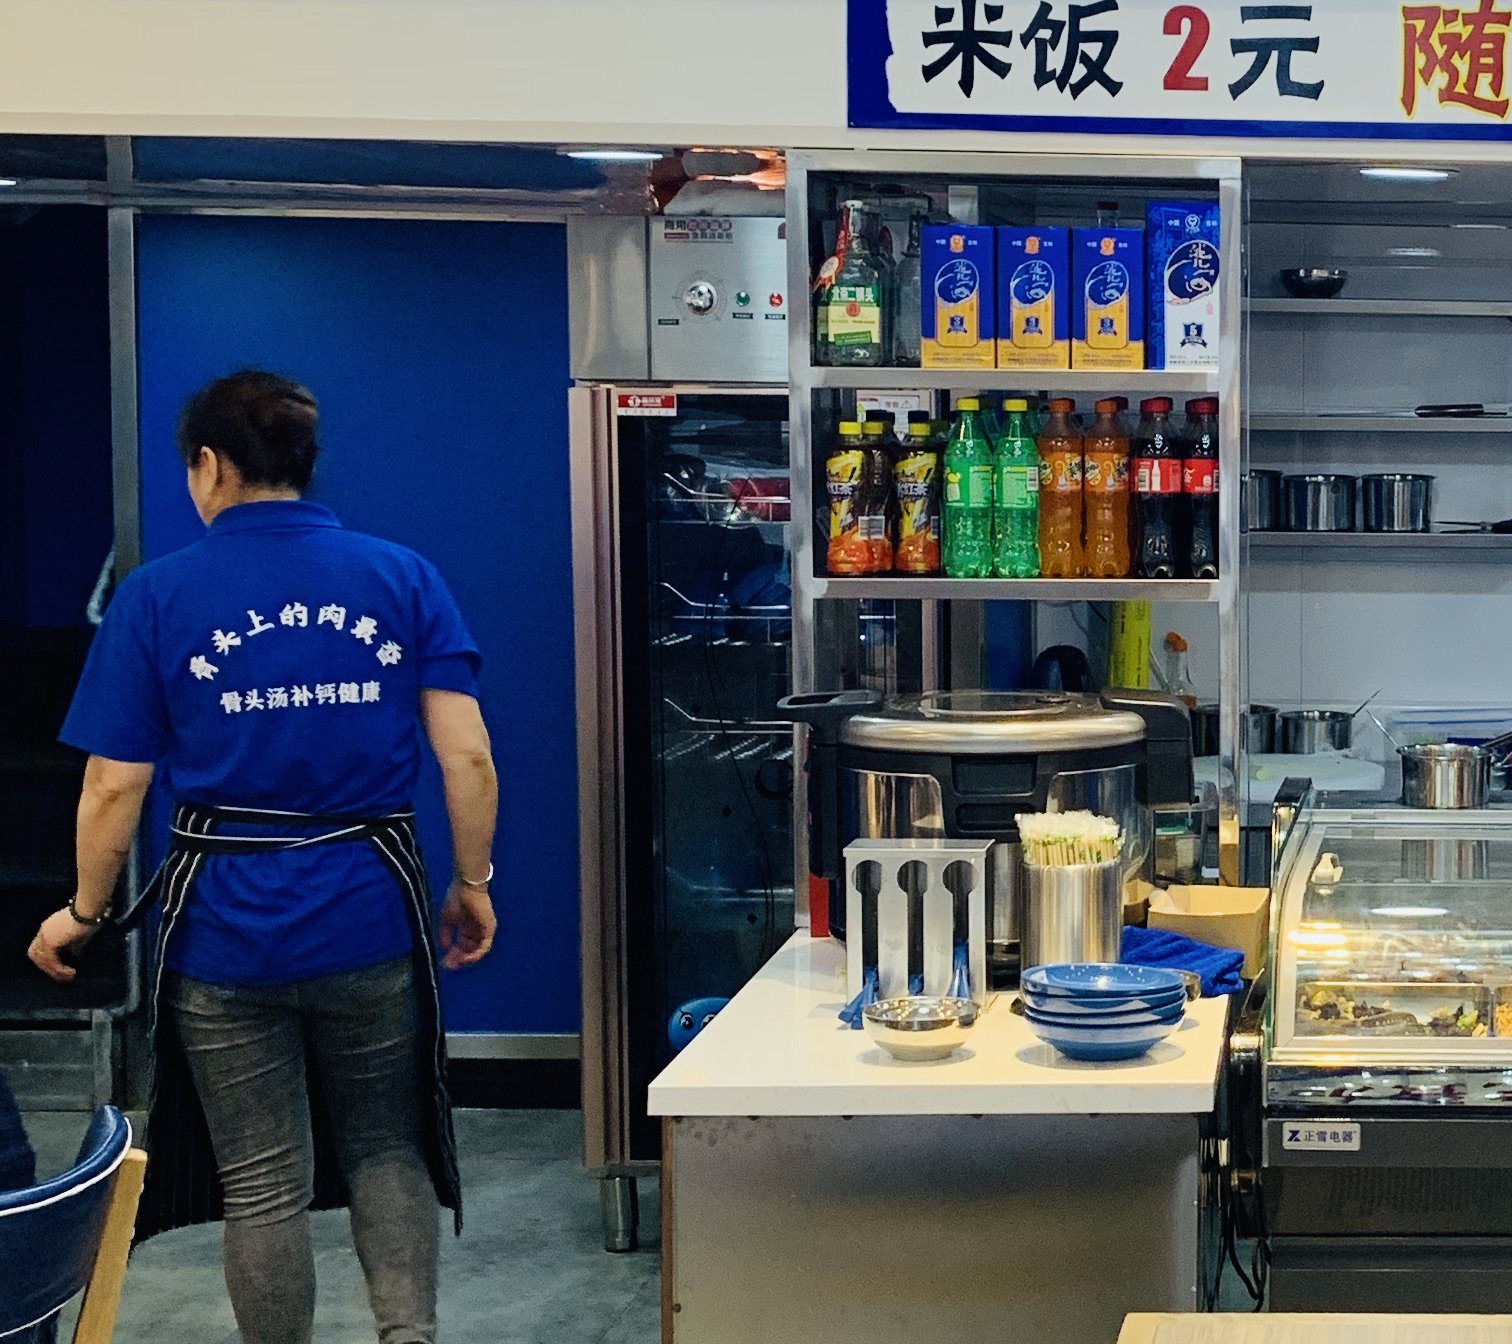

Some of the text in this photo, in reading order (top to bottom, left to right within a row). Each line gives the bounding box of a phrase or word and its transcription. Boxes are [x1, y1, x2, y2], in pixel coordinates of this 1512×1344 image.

[189, 602, 403, 681] 骨头上的肉最香
[220, 680, 381, 714] 骨头汤补钙健康
